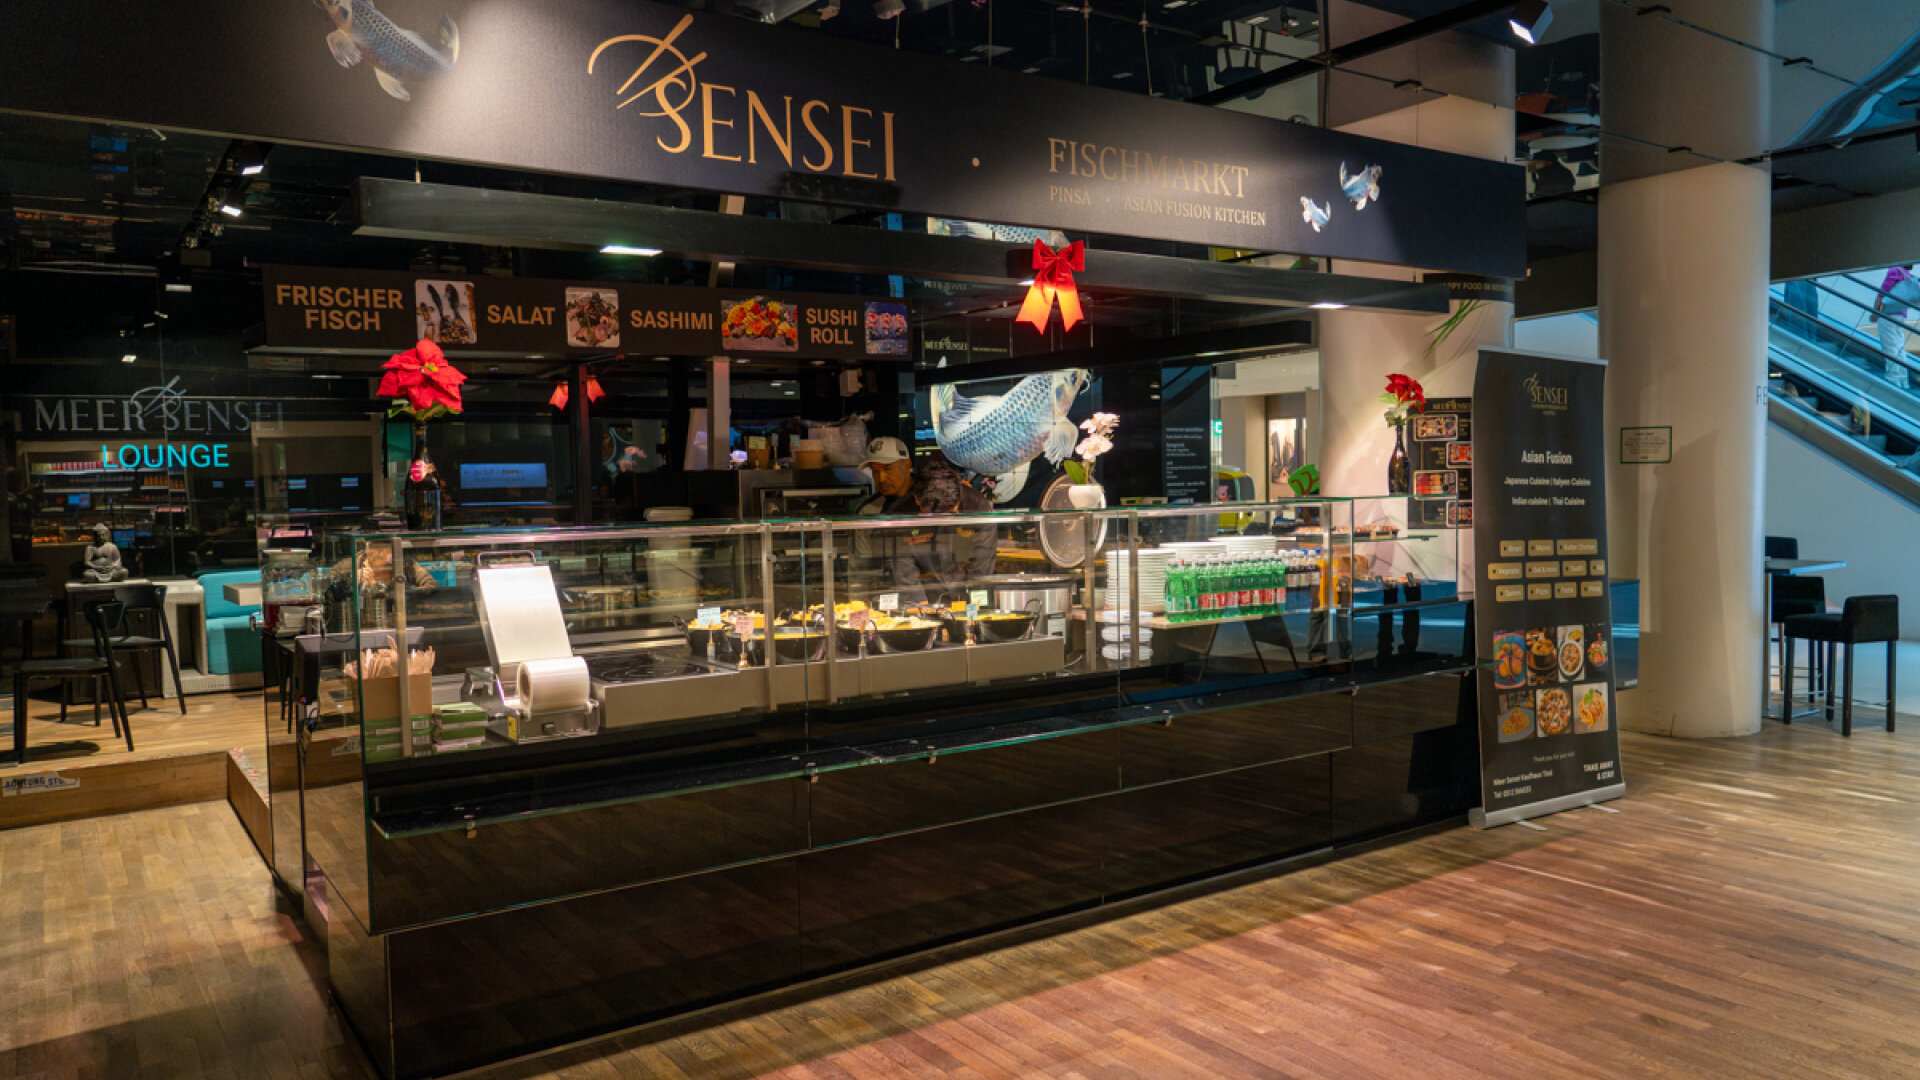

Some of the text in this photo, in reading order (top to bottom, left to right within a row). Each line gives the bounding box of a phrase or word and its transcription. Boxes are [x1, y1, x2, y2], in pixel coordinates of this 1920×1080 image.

[655, 77, 897, 181] SENSEI
[1048, 137, 1249, 199] FISCHMARKT
[1049, 186, 1091, 205] PINSA
[1123, 196, 1266, 226] ASIAN FUSION KITCHEN
[276, 284, 404, 309] FRISCHER
[305, 309, 382, 332] FISCH
[487, 304, 556, 326] SALAT
[630, 309, 713, 330] SASHIMI
[805, 307, 858, 326] SUSHI
[810, 327, 854, 345] ROLL
[1531, 386, 1567, 405] SENSEI
[35, 399, 284, 432] MEER SENSEI
[102, 444, 230, 468] LOUNGE
[1521, 450, 1572, 464] Asian Fusion
